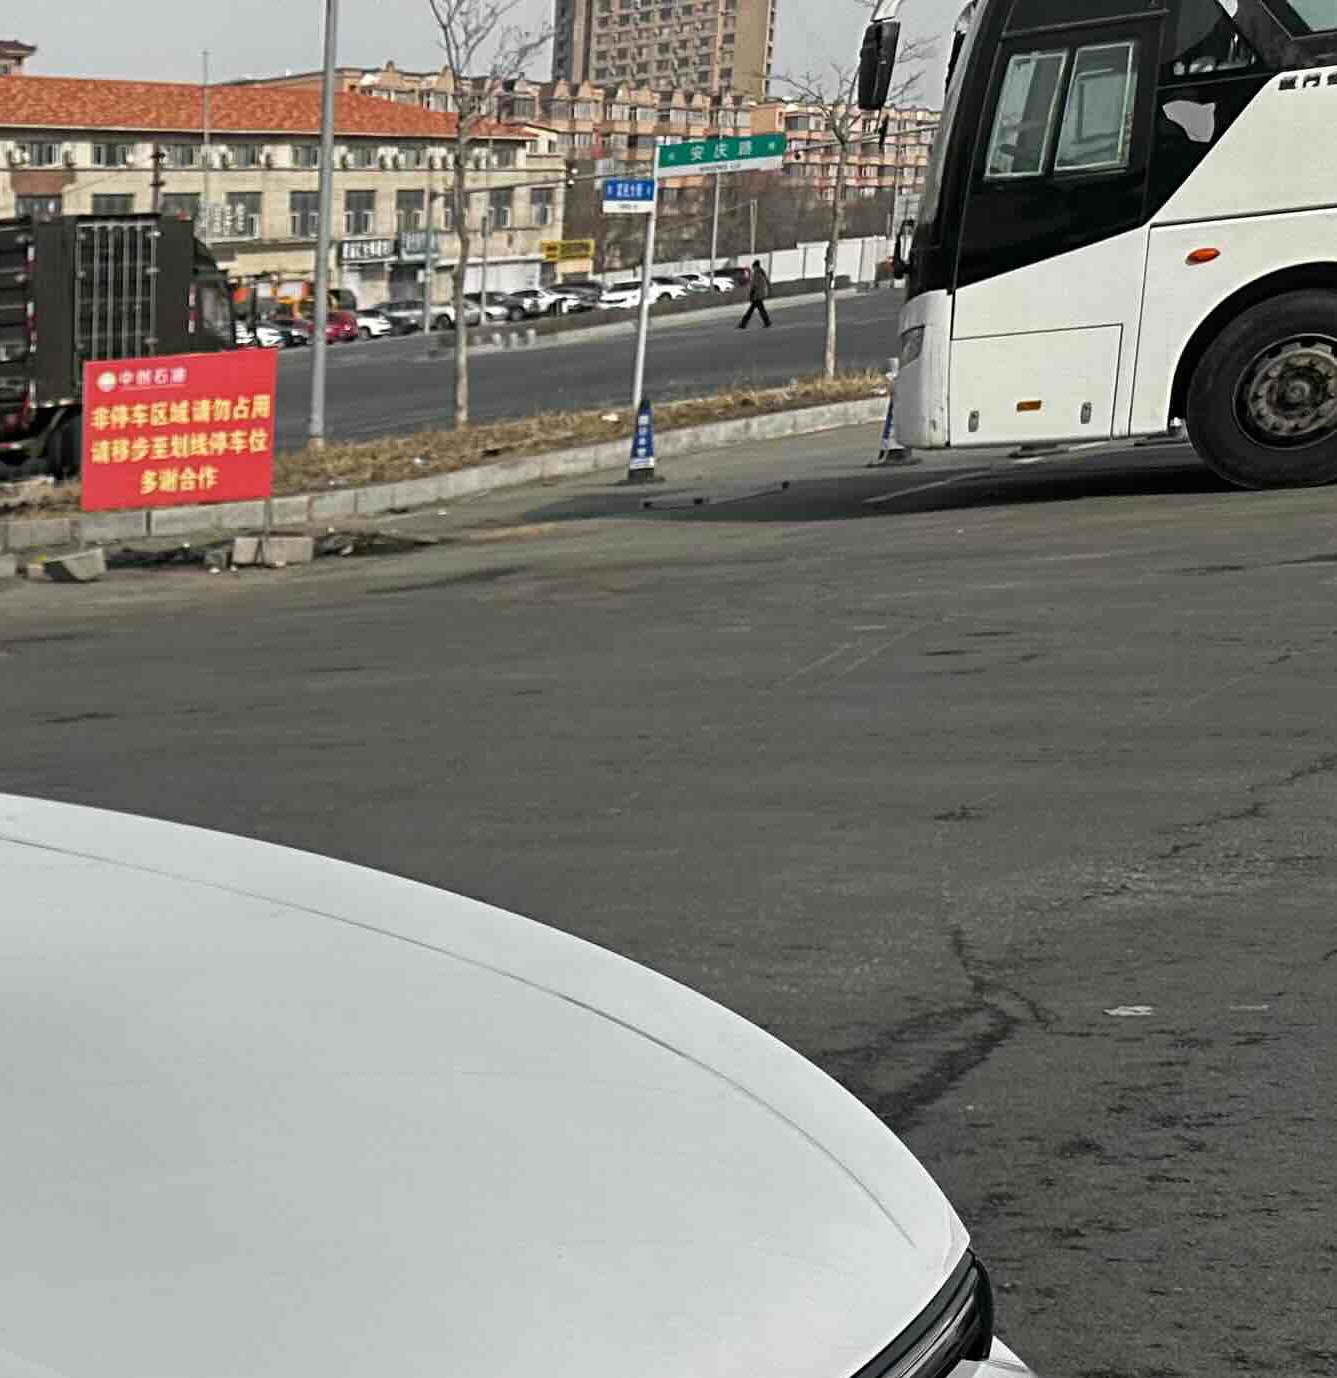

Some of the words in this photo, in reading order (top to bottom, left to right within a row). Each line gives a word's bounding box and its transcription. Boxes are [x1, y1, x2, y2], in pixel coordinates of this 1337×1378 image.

[92, 394, 271, 430] 非停车区域请勿占用
[91, 428, 269, 464] 请移步至划线停车位
[140, 464, 219, 495] 多谢合作
